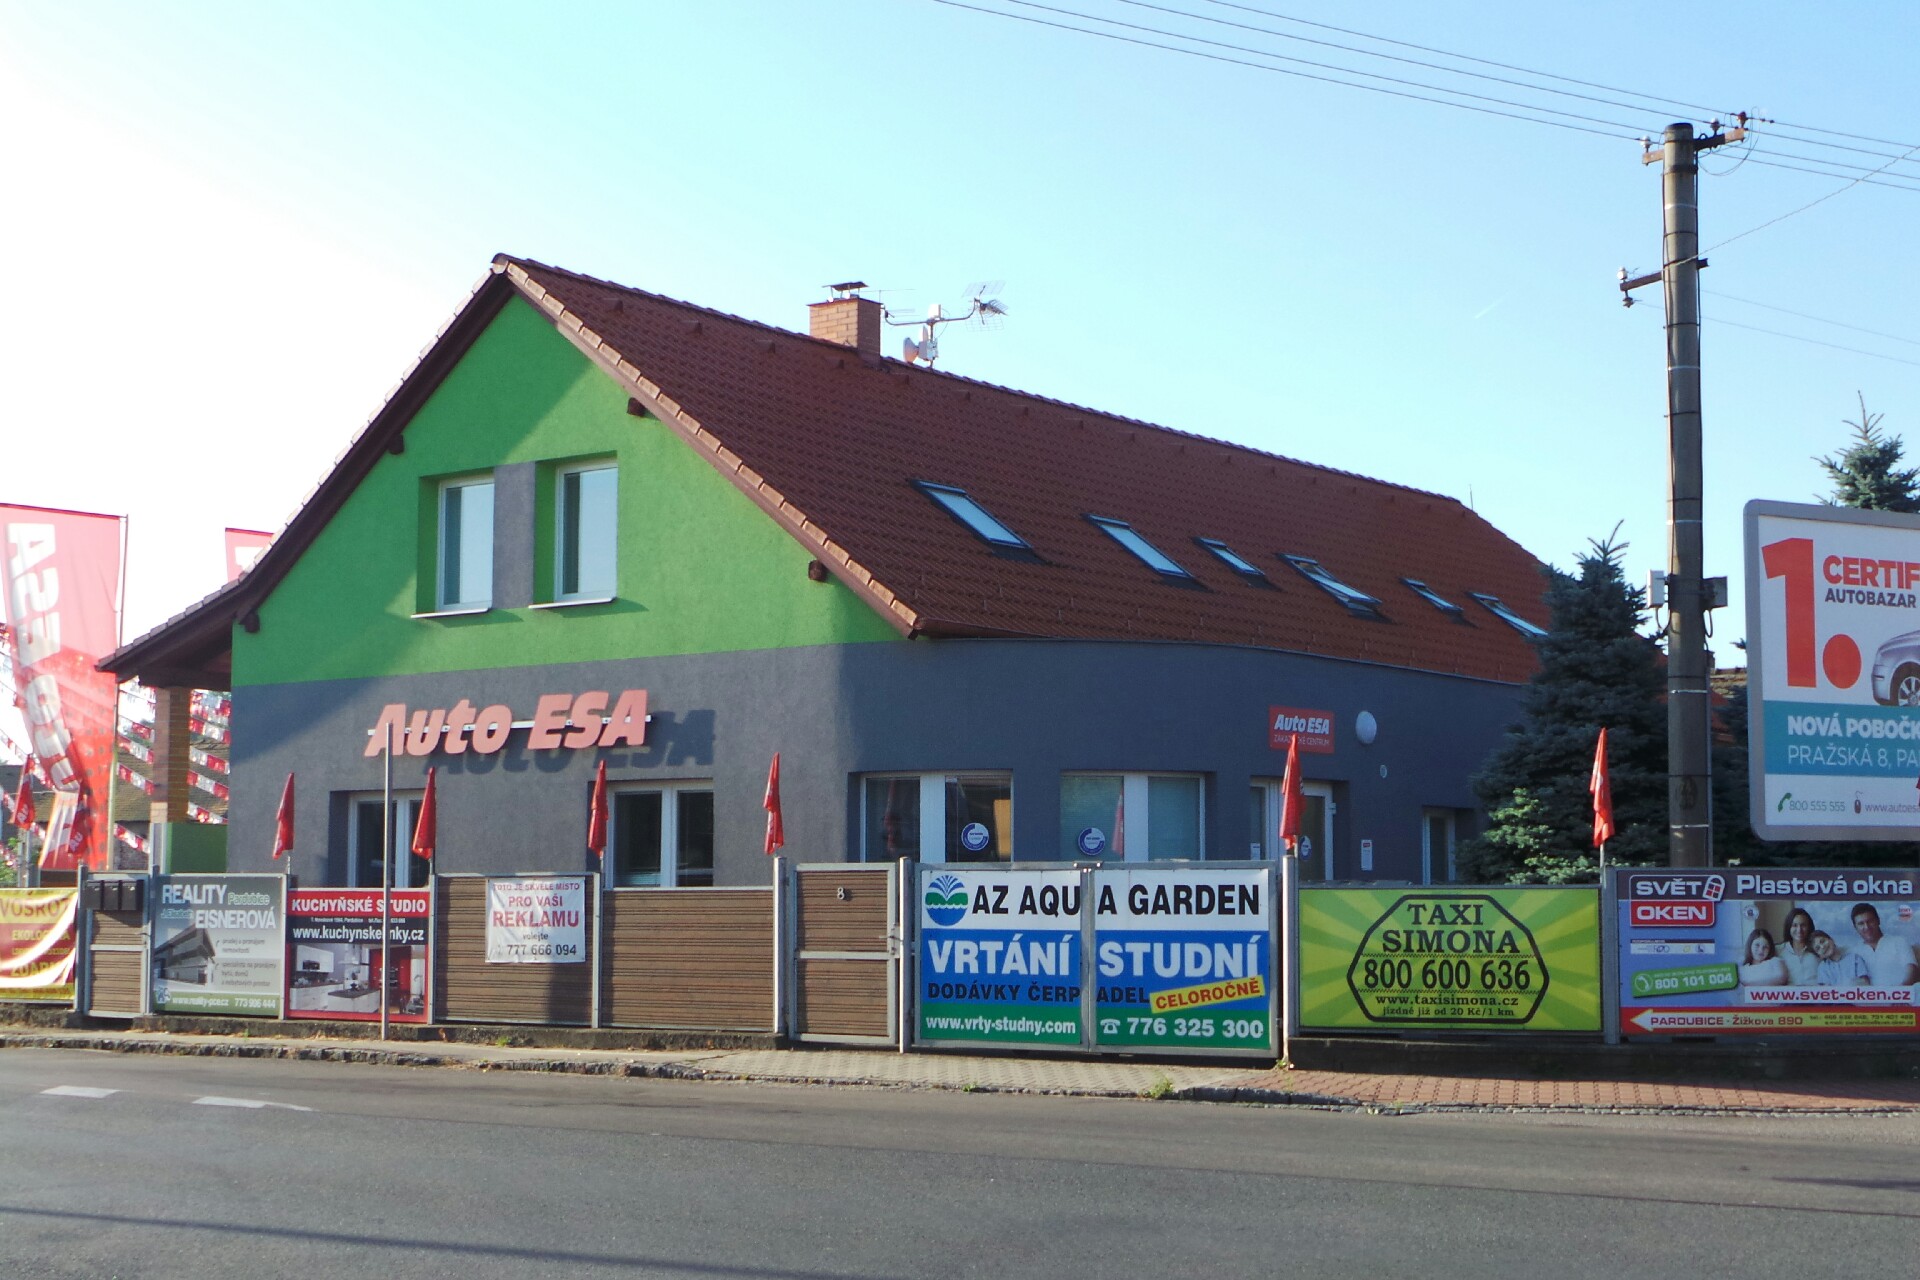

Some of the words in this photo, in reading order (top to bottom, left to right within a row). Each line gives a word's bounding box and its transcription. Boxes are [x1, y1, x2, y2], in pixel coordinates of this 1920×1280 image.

[1825, 588, 1917, 608] AUTOBAZAR
[364, 699, 513, 757] Auto
[528, 689, 649, 750] ESA
[1274, 714, 1306, 732] Auto
[1307, 717, 1330, 735] ESA
[1787, 712, 1843, 737] NOVÁ
[1788, 742, 1874, 766] PRAŽSKÁ
[1877, 748, 1892, 770] 8,
[1896, 749, 1920, 768] PA
[1789, 800, 1809, 811] 800
[1810, 801, 1827, 812] 555
[1829, 801, 1846, 812] 555
[162, 884, 228, 904] REALITY
[1636, 878, 1703, 896] SVĚT
[1737, 875, 1848, 895] Plastová
[1852, 875, 1913, 895] okna
[292, 896, 374, 913] KUCHYŇSKÉ
[508, 896, 532, 907] PRO
[536, 893, 563, 907] VAŠI
[972, 885, 1009, 915] AZ
[1128, 884, 1260, 916] GARDEN
[195, 906, 277, 929] EISNEROVÁ
[493, 910, 580, 928] REKLAMU
[1407, 904, 1484, 926] TAXI
[1636, 905, 1707, 920] OKEN
[523, 932, 549, 941] volejte
[1382, 930, 1520, 954] SIMONA
[507, 945, 526, 956] 777
[531, 945, 552, 956] 666
[555, 944, 577, 956] 094
[928, 933, 1073, 976] VRTÁNÍ
[1099, 935, 1260, 978] STUDNÍ
[1364, 960, 1412, 989] 800
[1422, 960, 1471, 989] 600
[1481, 960, 1530, 990] 636
[1655, 977, 1678, 989] 800
[1683, 975, 1705, 986] 101
[1709, 973, 1733, 984] 004
[928, 981, 1020, 1000] DODÁVKY
[1155, 979, 1261, 1009] CELOROČNĚ
[1375, 993, 1519, 1006] www.taxisimona.cz
[1751, 988, 1911, 1001] www.svet-oken.cz
[1383, 1006, 1414, 1016] jízdné
[1418, 1006, 1431, 1016] již
[1434, 1007, 1447, 1015] od
[1451, 1007, 1464, 1015] 20
[1497, 1007, 1514, 1016] km
[1650, 1017, 1724, 1025] PARDUBICE
[1732, 1015, 1774, 1025] Žižkova
[1778, 1017, 1803, 1025] 890
[926, 1014, 1076, 1036] www.vrty-studny.com
[1127, 1017, 1167, 1035] 776
[1174, 1018, 1215, 1036] 325
[1222, 1019, 1264, 1038] 300
